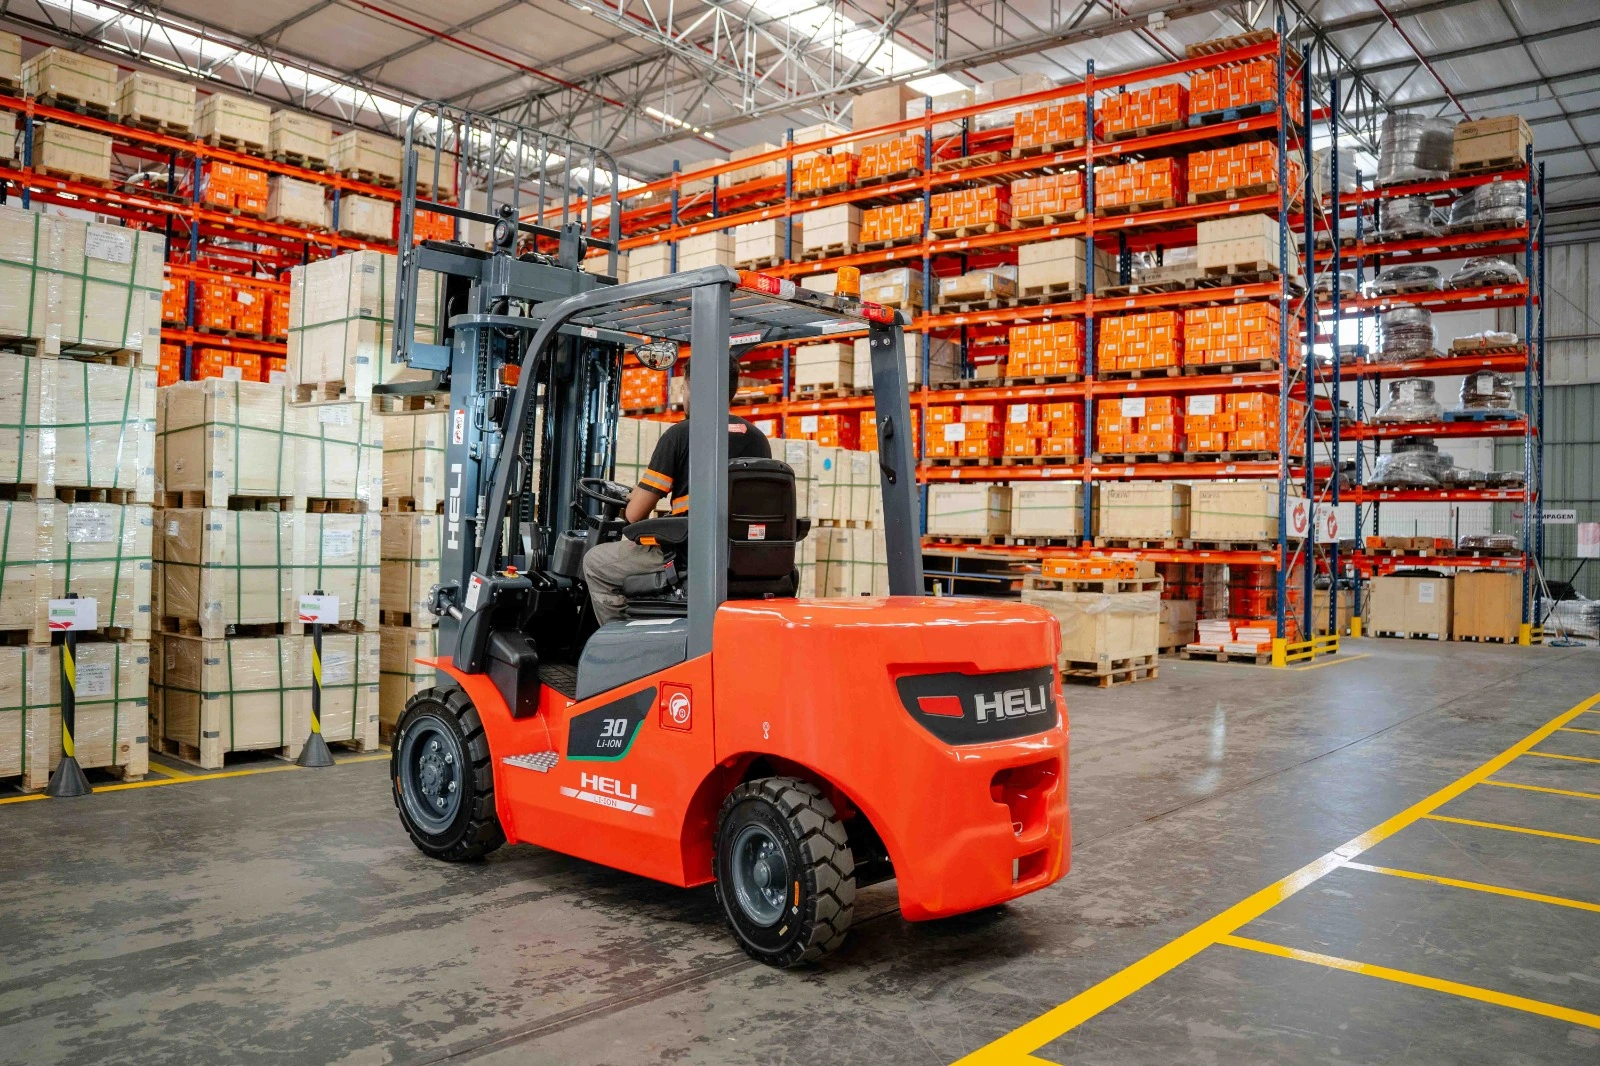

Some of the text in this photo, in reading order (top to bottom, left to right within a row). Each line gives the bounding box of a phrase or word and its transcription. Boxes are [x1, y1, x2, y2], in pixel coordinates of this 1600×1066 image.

[448, 464, 462, 549] HELI
[974, 685, 1047, 724] HELI
[600, 718, 628, 736] 30
[580, 772, 637, 800] HELI
